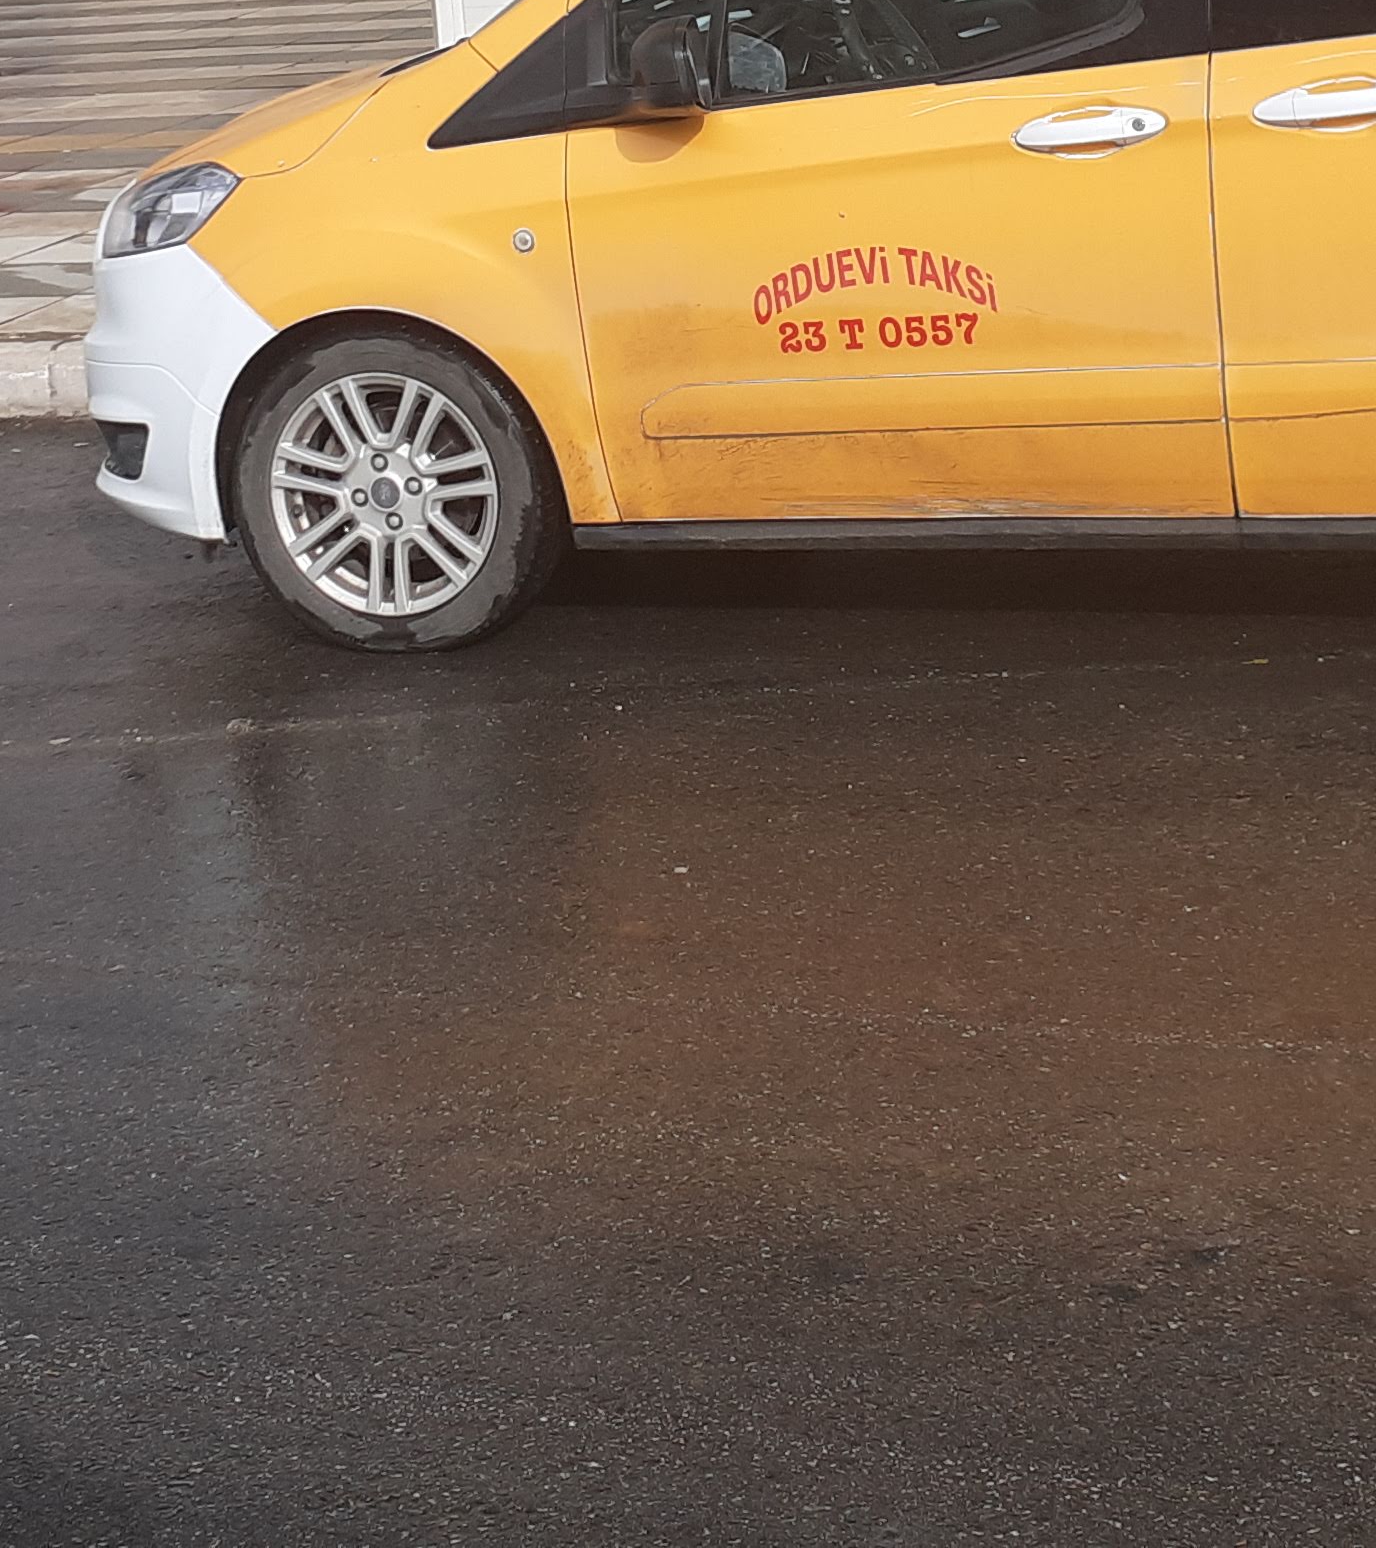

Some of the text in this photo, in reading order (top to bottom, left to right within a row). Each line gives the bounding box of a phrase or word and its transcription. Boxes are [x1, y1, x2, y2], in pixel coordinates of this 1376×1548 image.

[778, 312, 979, 354] 23 T 0557
